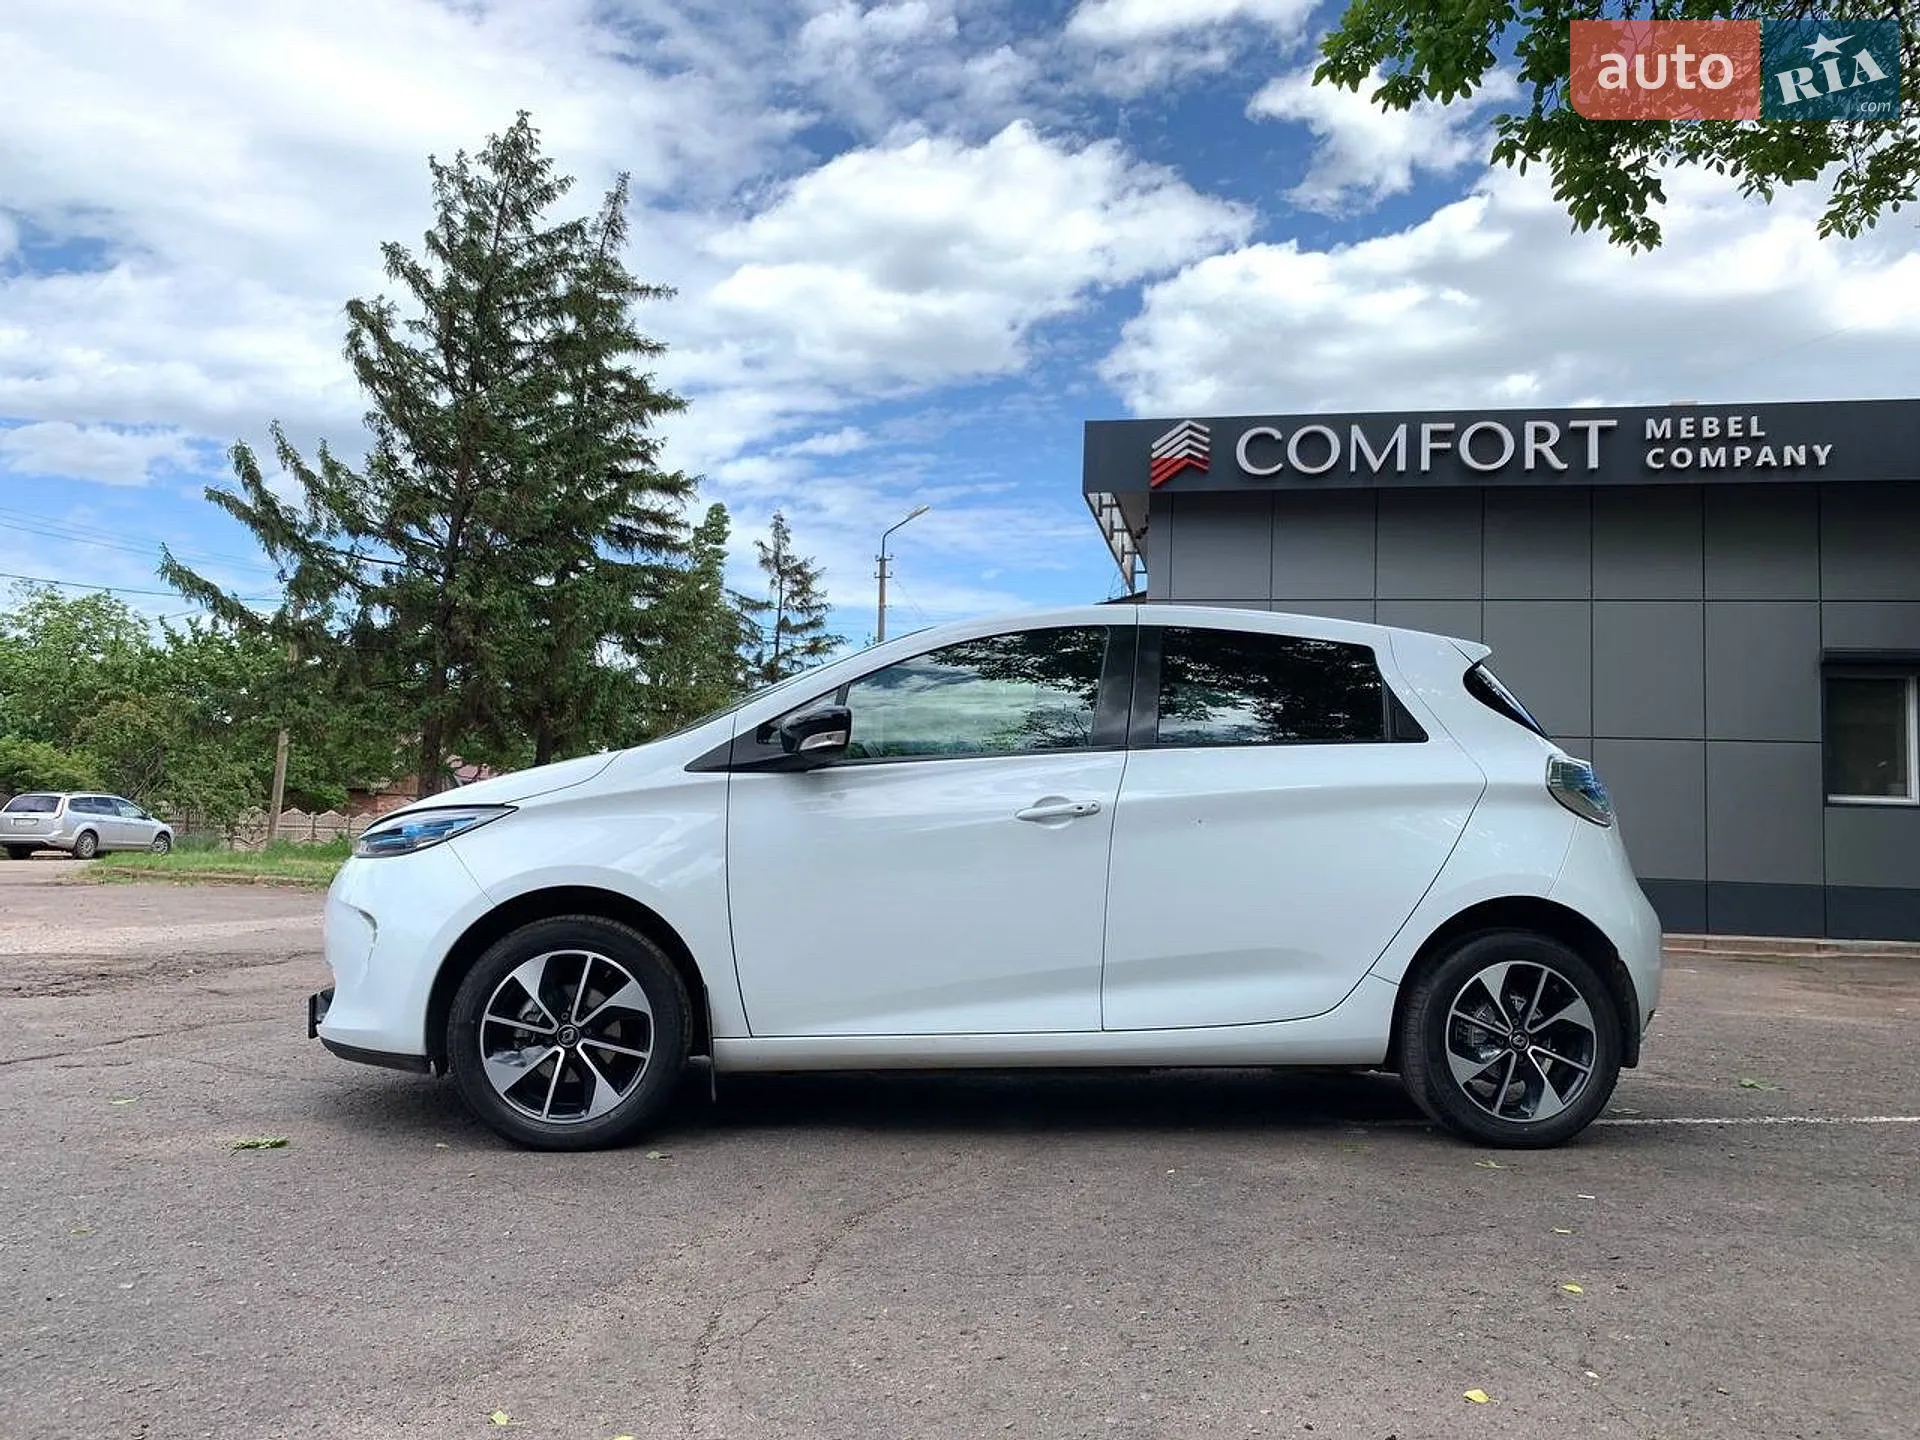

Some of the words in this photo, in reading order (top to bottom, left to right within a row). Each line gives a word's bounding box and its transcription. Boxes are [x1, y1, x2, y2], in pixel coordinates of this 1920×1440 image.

[1645, 416, 1766, 439] MEBEL
[1235, 420, 1618, 476] COMFORT
[1645, 444, 1833, 469] COMPANY
